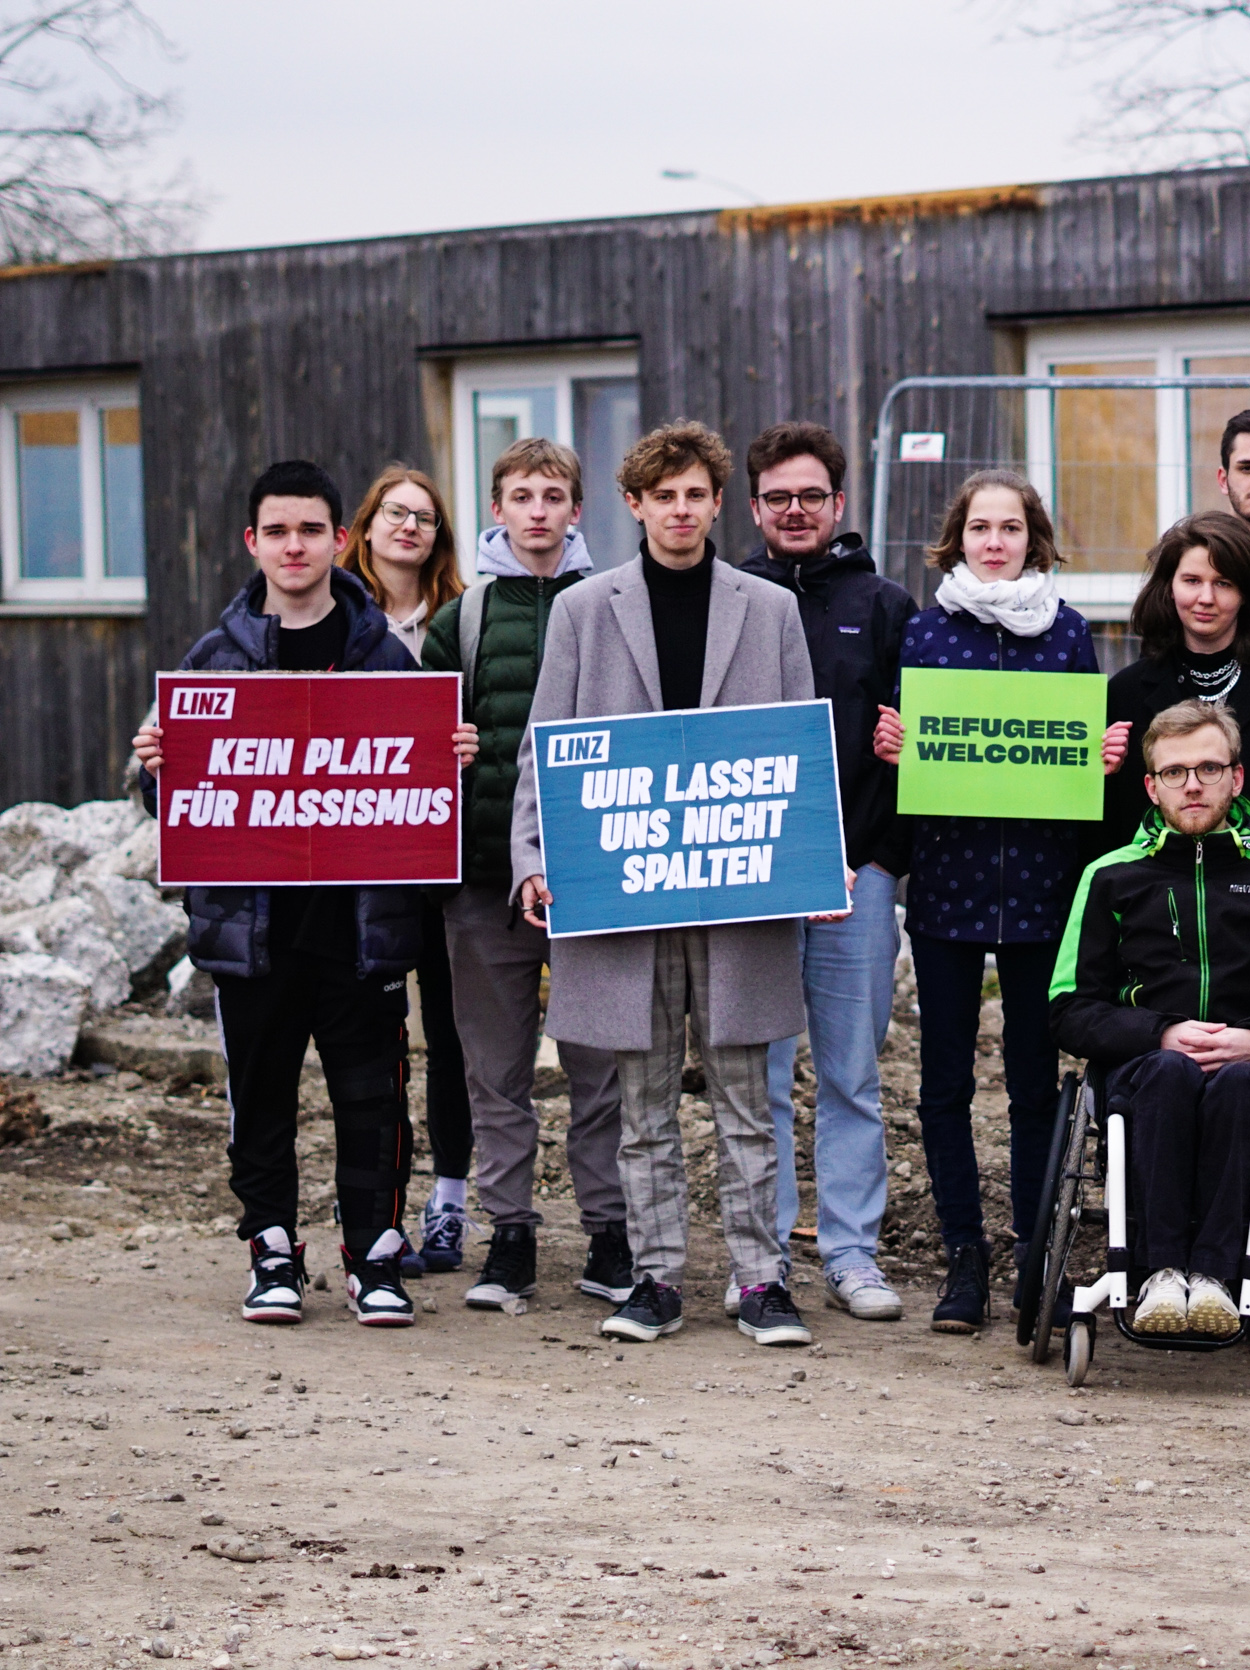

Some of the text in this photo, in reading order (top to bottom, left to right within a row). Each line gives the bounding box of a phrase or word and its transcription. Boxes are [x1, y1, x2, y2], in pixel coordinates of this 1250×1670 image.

[176, 692, 229, 716] LINZ
[919, 715, 1088, 741] REFUGEES
[207, 738, 415, 776] KEIN PLATZ
[553, 735, 604, 763] LINZ
[917, 741, 1089, 767] WELCOME!
[581, 754, 799, 810] WIR LASSEN
[168, 781, 453, 827] FÜR RASSISMUS
[600, 799, 789, 852] UNS NICHT
[621, 844, 774, 894] SPALTEN
